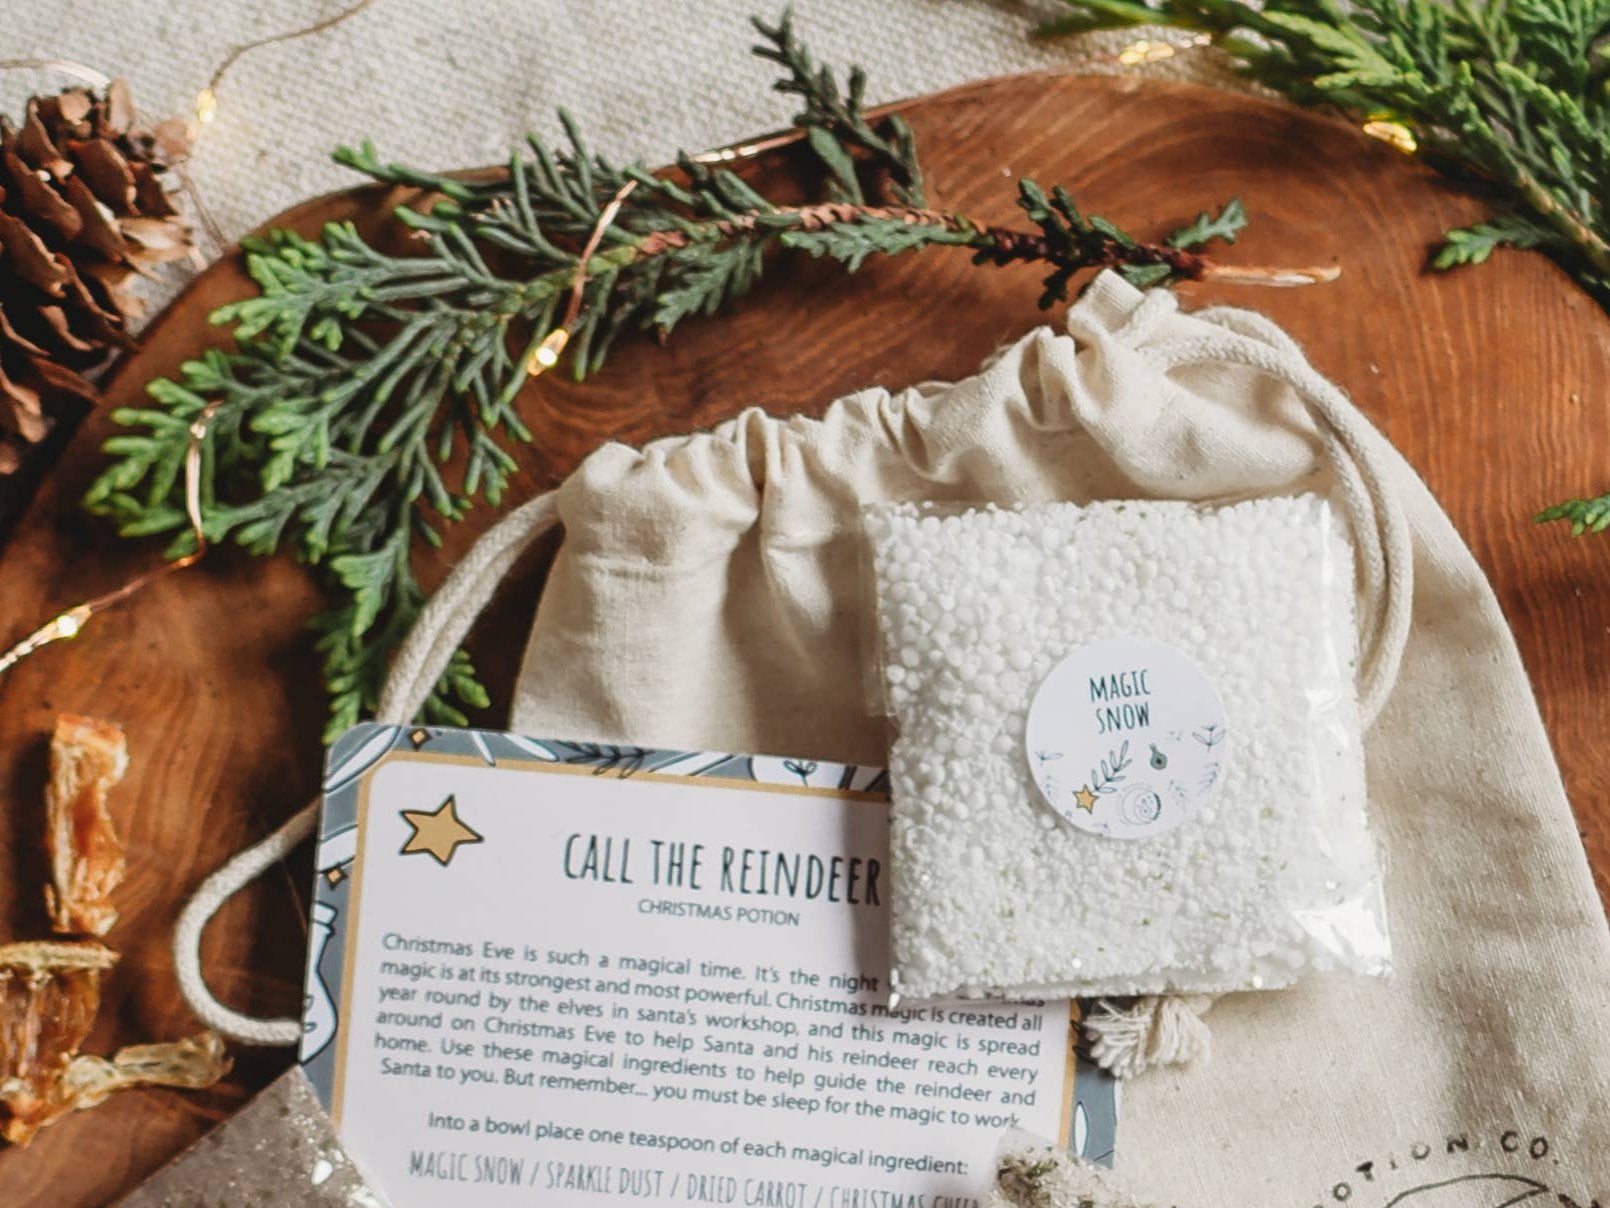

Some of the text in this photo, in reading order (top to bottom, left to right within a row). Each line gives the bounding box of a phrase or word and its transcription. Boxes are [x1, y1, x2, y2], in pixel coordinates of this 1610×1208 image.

[1089, 669, 1151, 703] MAGIC
[1096, 701, 1150, 734] SNOW
[564, 833, 884, 907] CALL THE REINDEER
[638, 899, 800, 926] CHRISTMAS POTION
[382, 933, 473, 956] Christmas
[483, 941, 515, 960] Eve
[524, 946, 537, 962] is
[547, 949, 589, 966] such
[599, 955, 609, 968] a
[619, 957, 691, 975] magical
[700, 961, 745, 980] time.
[756, 966, 780, 983] It's
[790, 968, 820, 987] the
[829, 971, 879, 993] night
[378, 981, 1040, 1056] year round by the elves in santa's workshop, and this magic is spread
[374, 1032, 1036, 1106] home. Use these magical ingredients to help guide the reindeer and
[428, 1112, 968, 1175] Into a bowl place one teaspoon of each magical ingredient:
[410, 1151, 467, 1181] MAGIC
[474, 1155, 523, 1185] SNOW
[547, 1161, 611, 1193] SPARKLE
[619, 1168, 664, 1197] DUST
[687, 1173, 737, 1203] DRIED
[745, 1179, 807, 1208] CARROT
